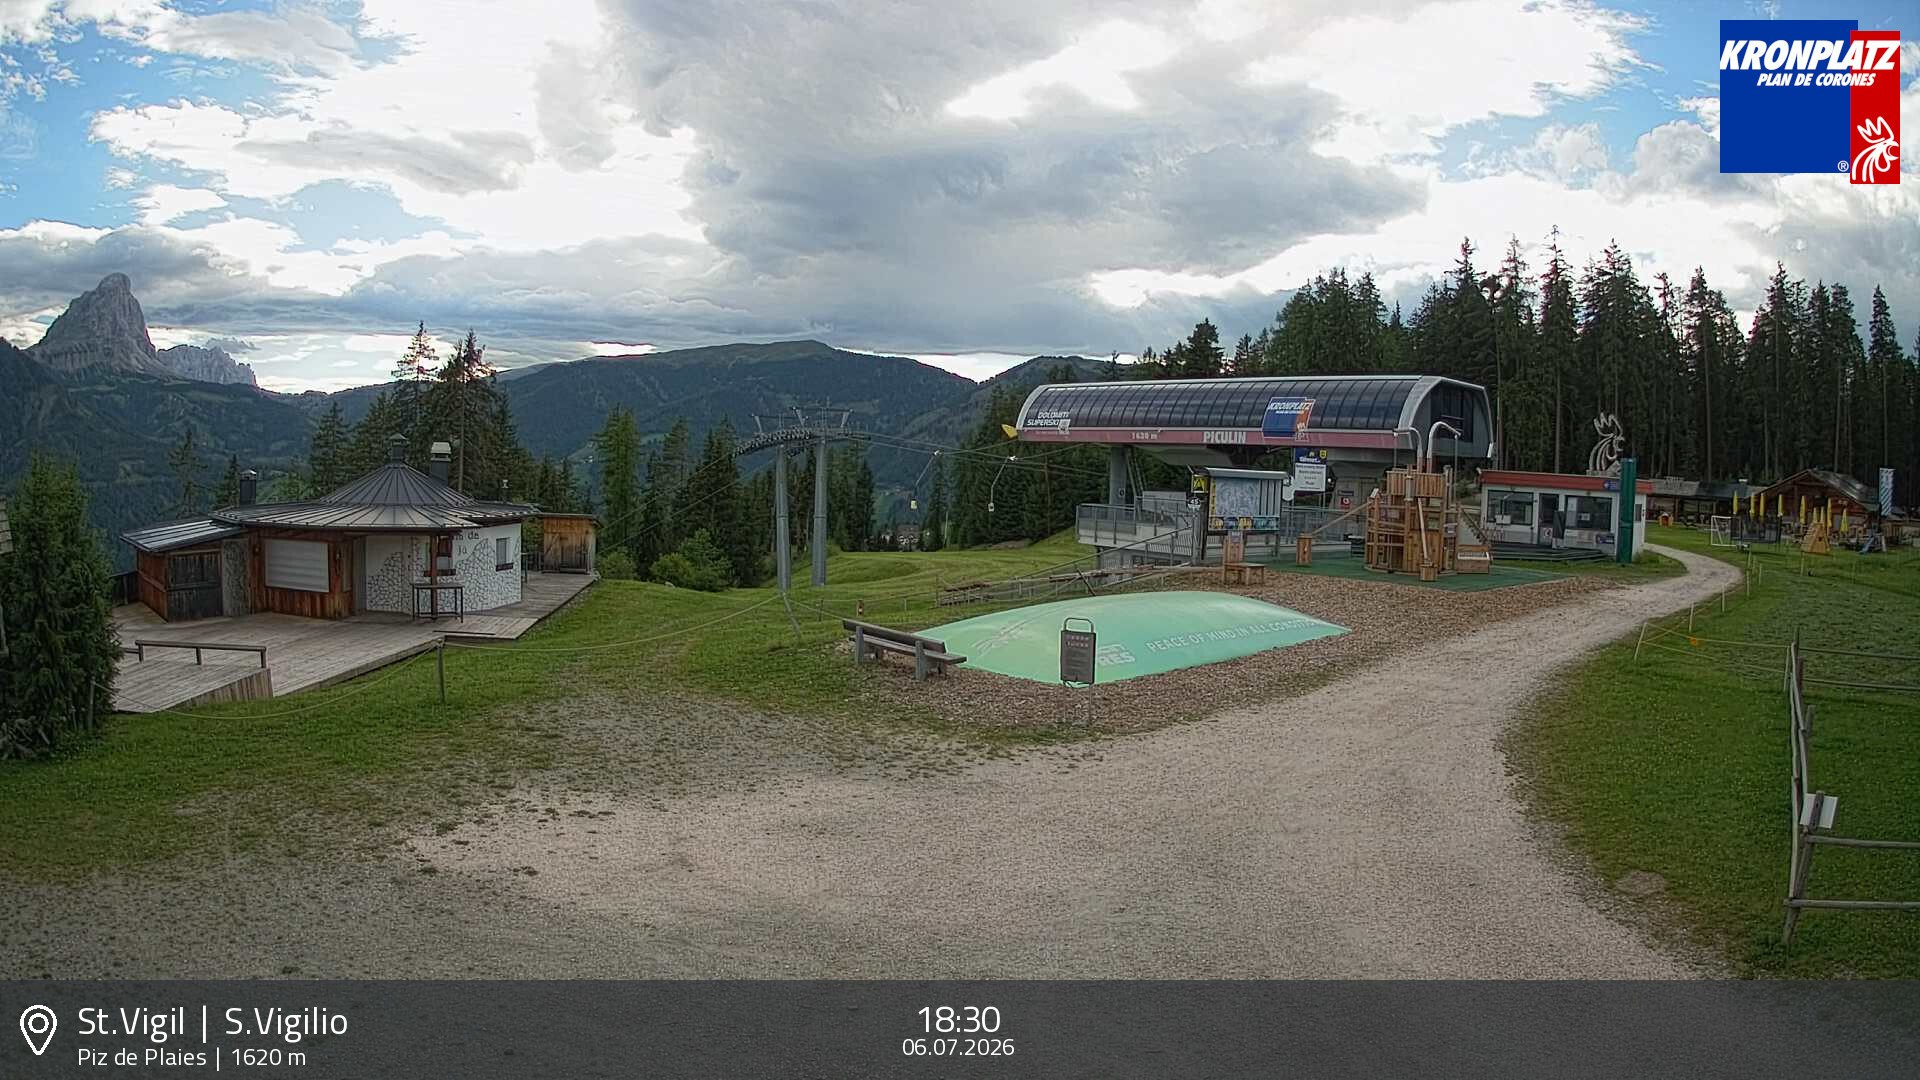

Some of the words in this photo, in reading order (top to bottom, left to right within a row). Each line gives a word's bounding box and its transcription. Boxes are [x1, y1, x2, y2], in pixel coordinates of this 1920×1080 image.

[1203, 431, 1247, 444] PICULIN
[1145, 635, 1189, 652] PEACE
[1189, 632, 1206, 644] OF
[1207, 629, 1236, 641] MIND
